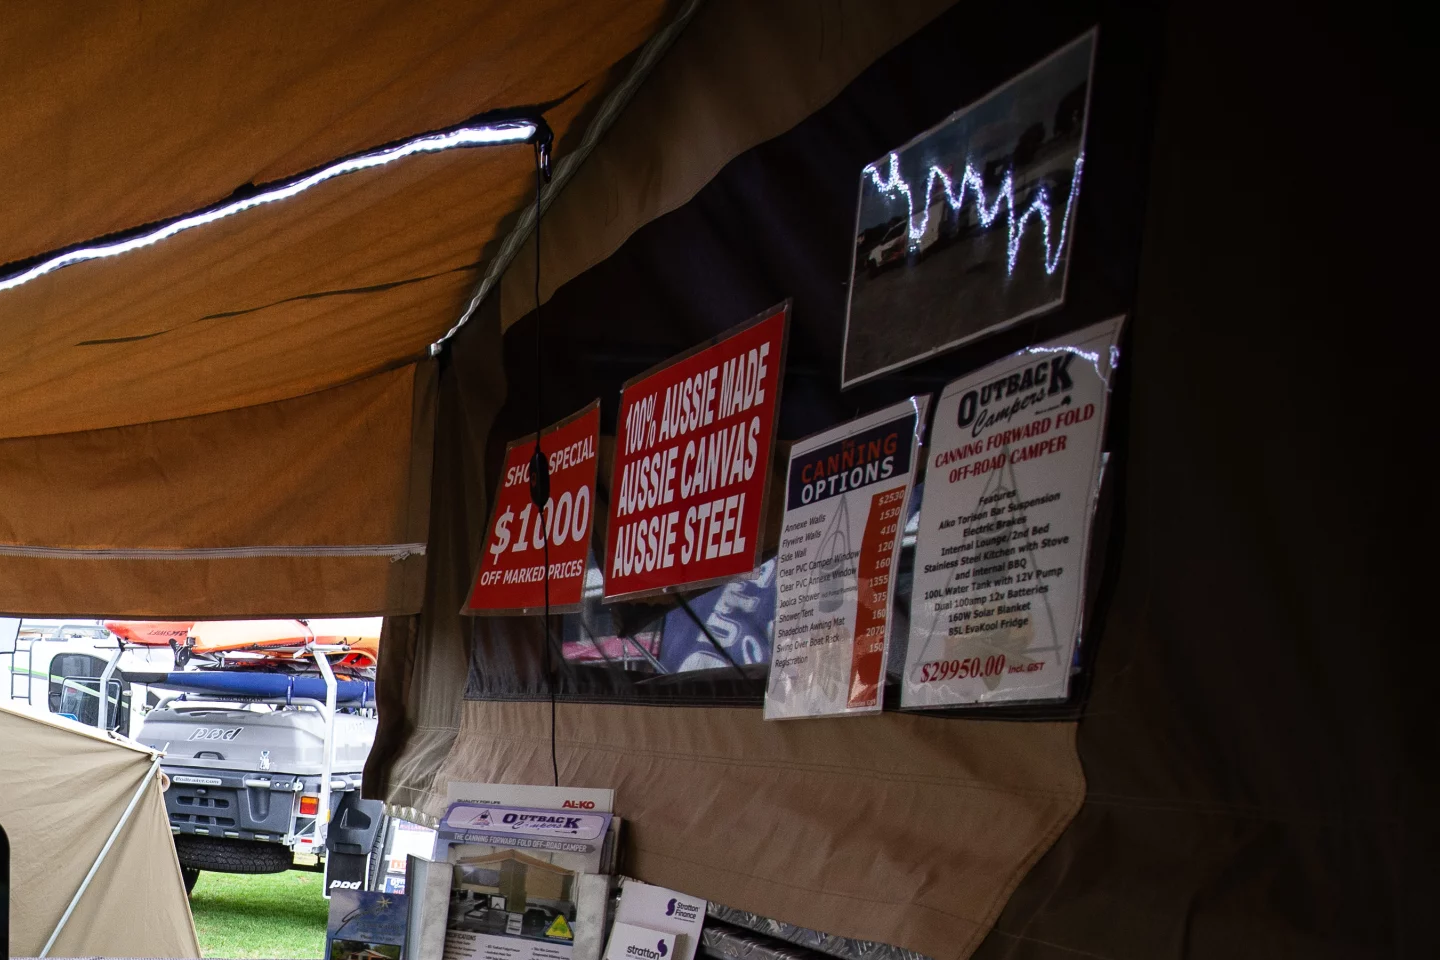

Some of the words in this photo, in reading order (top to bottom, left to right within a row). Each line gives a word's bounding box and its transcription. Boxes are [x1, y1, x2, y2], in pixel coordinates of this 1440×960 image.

[625, 391, 658, 455] 100%
[659, 365, 717, 441] AUSSIE
[718, 342, 771, 421] MADE
[957, 352, 1074, 429] OUTBACK
[972, 387, 1045, 438] Campers
[935, 440, 983, 468] CANNING
[986, 418, 1051, 451] FORWARD
[1055, 403, 1095, 430] FOLD
[549, 435, 595, 475] SPECIAL
[801, 433, 899, 484] CANNING
[949, 454, 1006, 484] OFF-ROAD
[1010, 435, 1067, 465] CAMPER
[617, 454, 679, 518] AUSSIE
[680, 416, 760, 500] CANVAS
[801, 456, 894, 504] OPTIONS
[878, 490, 905, 506] $2530
[979, 489, 1017, 506] Features
[990, 505, 1006, 517] Bar
[1007, 491, 1060, 513] Suspension
[880, 507, 901, 520] 1530
[489, 485, 591, 566] $1000
[785, 520, 807, 533] Annexe
[810, 514, 826, 526] Walls
[880, 523, 896, 535] 410
[963, 522, 994, 537] Electric
[996, 515, 1027, 531] Brakes
[612, 512, 679, 578] AUSSIE
[681, 492, 746, 565] STEEL
[782, 535, 803, 548] Flywire
[805, 529, 821, 541] Walls
[941, 541, 973, 556] Internal
[975, 529, 1029, 549] Lounge/2nd
[1032, 524, 1050, 536] Bed
[781, 551, 793, 563] Side
[795, 548, 806, 559] Wall
[878, 541, 893, 553] 120
[924, 558, 959, 574] Stainless
[960, 554, 981, 566] Steel
[983, 547, 1015, 561] Kitchen
[1018, 542, 1039, 553] with
[1040, 535, 1069, 549] Stove
[481, 569, 502, 586] OFF
[504, 565, 545, 584] MARKED
[548, 559, 583, 580] PRICES
[779, 566, 794, 577] Clear
[796, 562, 807, 573] PVC
[809, 557, 832, 571] Camper
[834, 551, 860, 563] Window
[875, 558, 891, 570] 160
[955, 570, 970, 581] and
[972, 562, 1005, 577] internal
[1007, 558, 1027, 571] BBQ
[780, 582, 794, 593] Clear
[796, 579, 807, 588] PVC
[809, 573, 831, 585] Annexe
[832, 568, 857, 580] Window
[869, 575, 889, 587] 1355
[924, 587, 943, 600] 100L
[945, 585, 969, 596] Water
[972, 580, 992, 591] Tank
[994, 576, 1013, 586] with
[1016, 572, 1034, 583] 12V
[1035, 567, 1064, 580] Pump
[798, 591, 820, 603] Shower
[873, 593, 887, 603] 375
[934, 602, 952, 612] Dual
[954, 595, 987, 610] 100amp
[1007, 584, 1049, 598] Batteries
[779, 612, 800, 623] Shower
[801, 608, 814, 618] Tent
[872, 609, 886, 620] 160
[949, 612, 972, 623] 160W
[973, 607, 995, 620] Solar
[997, 602, 1031, 616] Blanket
[778, 623, 809, 638] Shadecloth
[810, 620, 832, 633] Awning
[833, 617, 845, 626] Mat
[866, 626, 885, 637] 2070
[949, 625, 964, 636] 85L
[965, 620, 998, 634] EvaKool
[1000, 617, 1028, 630] Fridge
[777, 641, 793, 653] Swing
[794, 640, 808, 649] Over
[810, 637, 824, 647] Boat
[869, 643, 883, 653] 150
[774, 655, 809, 668] Registration
[920, 655, 1006, 683] $29950.00
[1027, 662, 1045, 672] GST
[187, 727, 244, 741] pod
[562, 800, 595, 809] AL-KO
[502, 813, 582, 829] OUTBACK
[464, 834, 489, 843] CANNING
[489, 836, 516, 846] FORWARD
[517, 839, 532, 847] FOLD
[533, 841, 562, 850] OFF-ROAD
[562, 843, 587, 853] CAMPER
[329, 880, 362, 890] pod
[675, 909, 697, 920] Finance
[677, 901, 699, 913] Stratton
[627, 945, 660, 960] stratton
